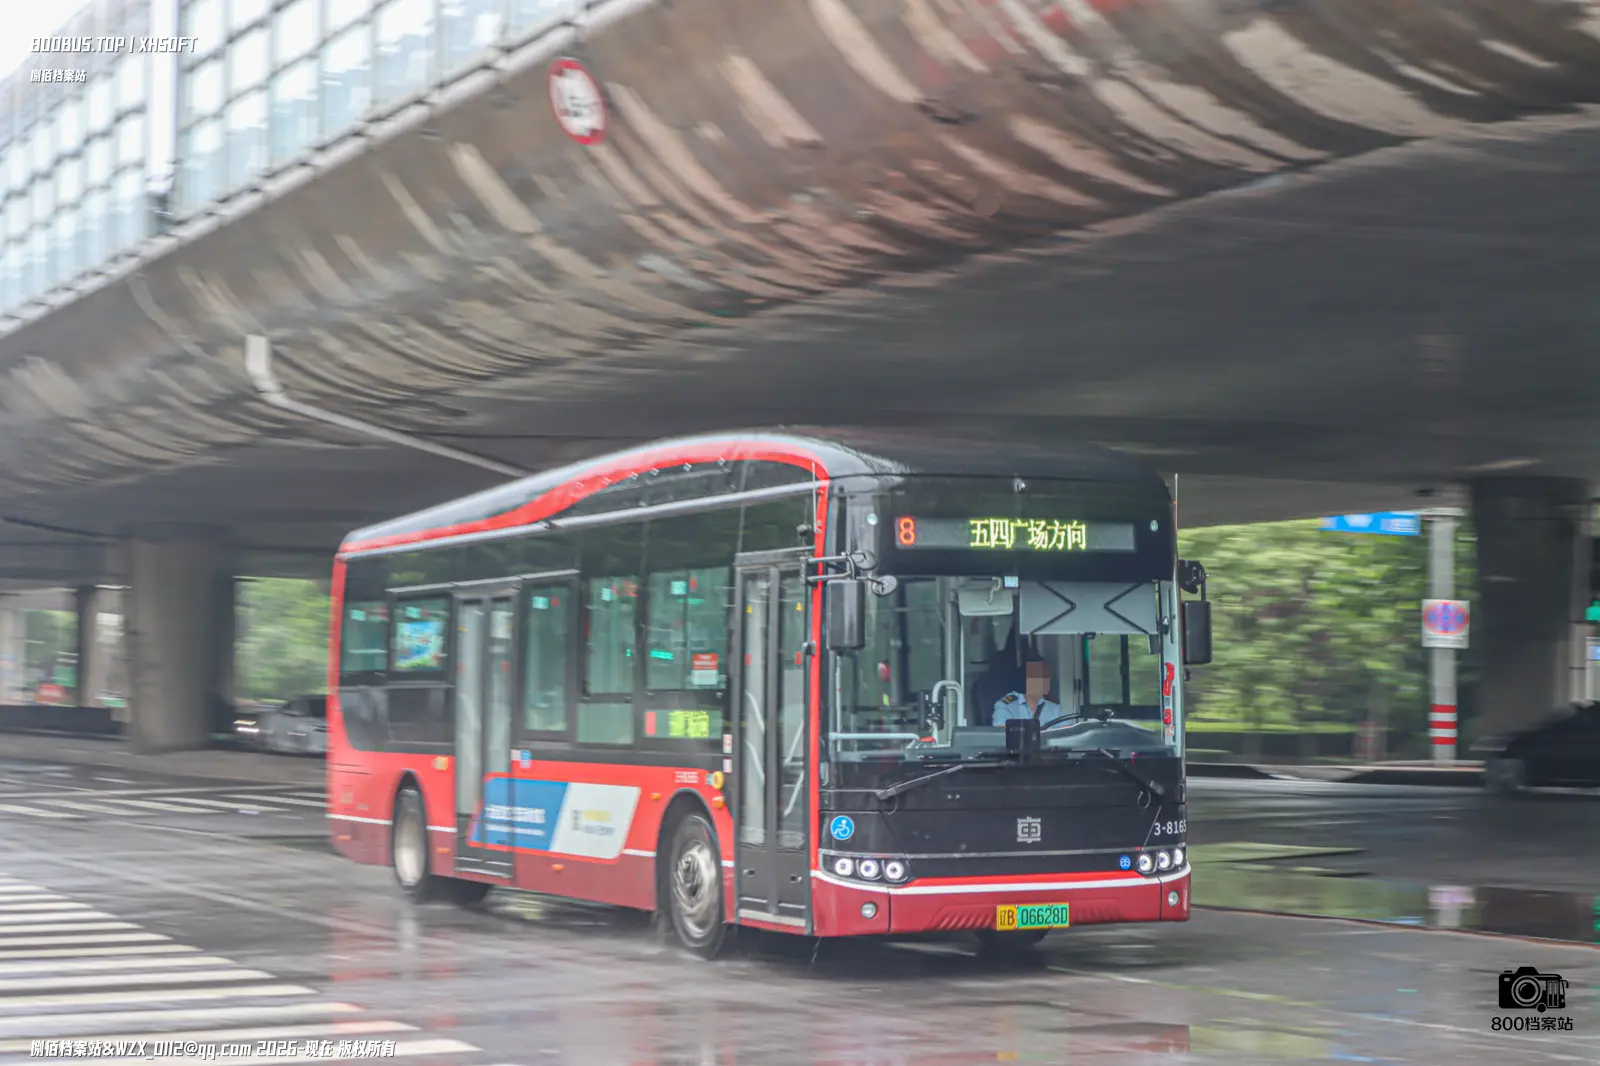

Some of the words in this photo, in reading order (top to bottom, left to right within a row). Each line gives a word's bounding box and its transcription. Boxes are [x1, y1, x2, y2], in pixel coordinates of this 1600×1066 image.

[899, 516, 916, 545] 8
[969, 518, 1086, 550] 五四广场方向
